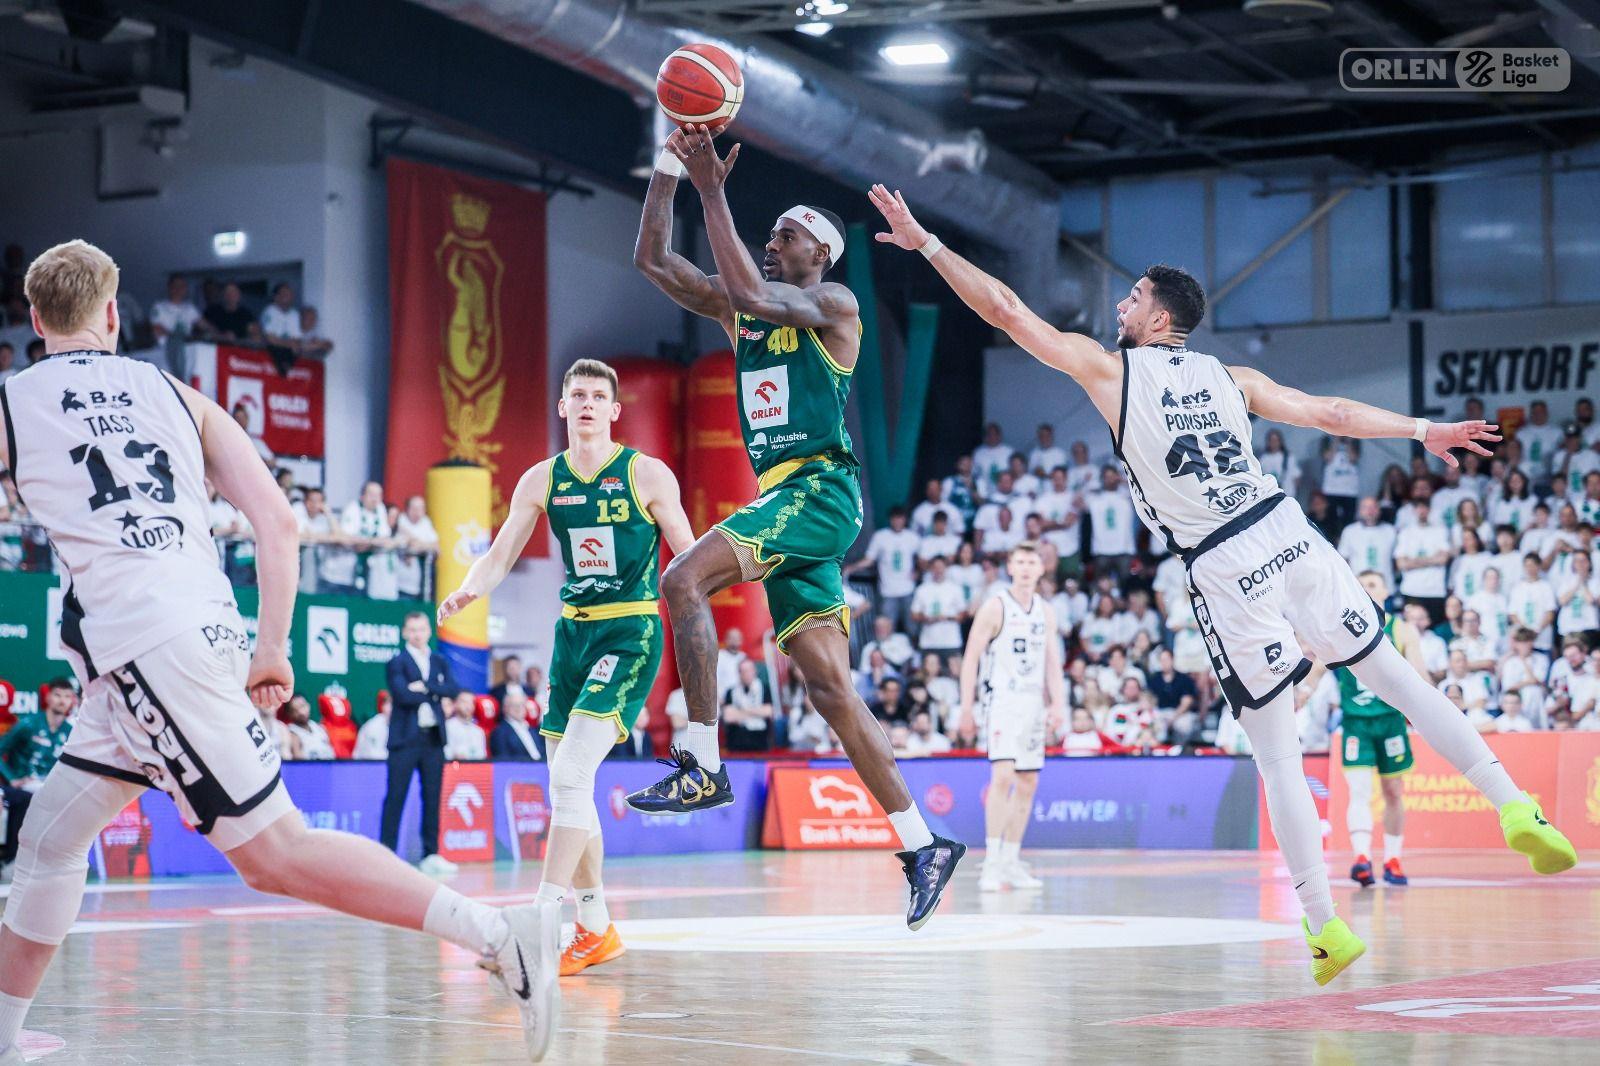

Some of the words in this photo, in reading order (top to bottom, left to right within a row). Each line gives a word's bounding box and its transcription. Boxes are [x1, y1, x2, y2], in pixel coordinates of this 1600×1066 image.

[801, 212, 816, 223] KC
[767, 326, 799, 355] 40
[1435, 344, 1573, 398] SEKTOR
[1576, 342, 1600, 390] F
[751, 406, 782, 420] ORLEN
[1165, 411, 1221, 432] PONSAR
[83, 414, 135, 437] TASS
[769, 431, 808, 444] Lubuskie
[1165, 430, 1250, 483] 42
[69, 439, 177, 512] 13
[1215, 486, 1247, 510] LOTTO
[596, 498, 630, 523] 13
[578, 559, 609, 568] ORLEN
[1238, 541, 1306, 596] pompax
[1246, 584, 1273, 602] SERWIS
[352, 622, 400, 647] ORLEN
[800, 824, 840, 845] Bank
